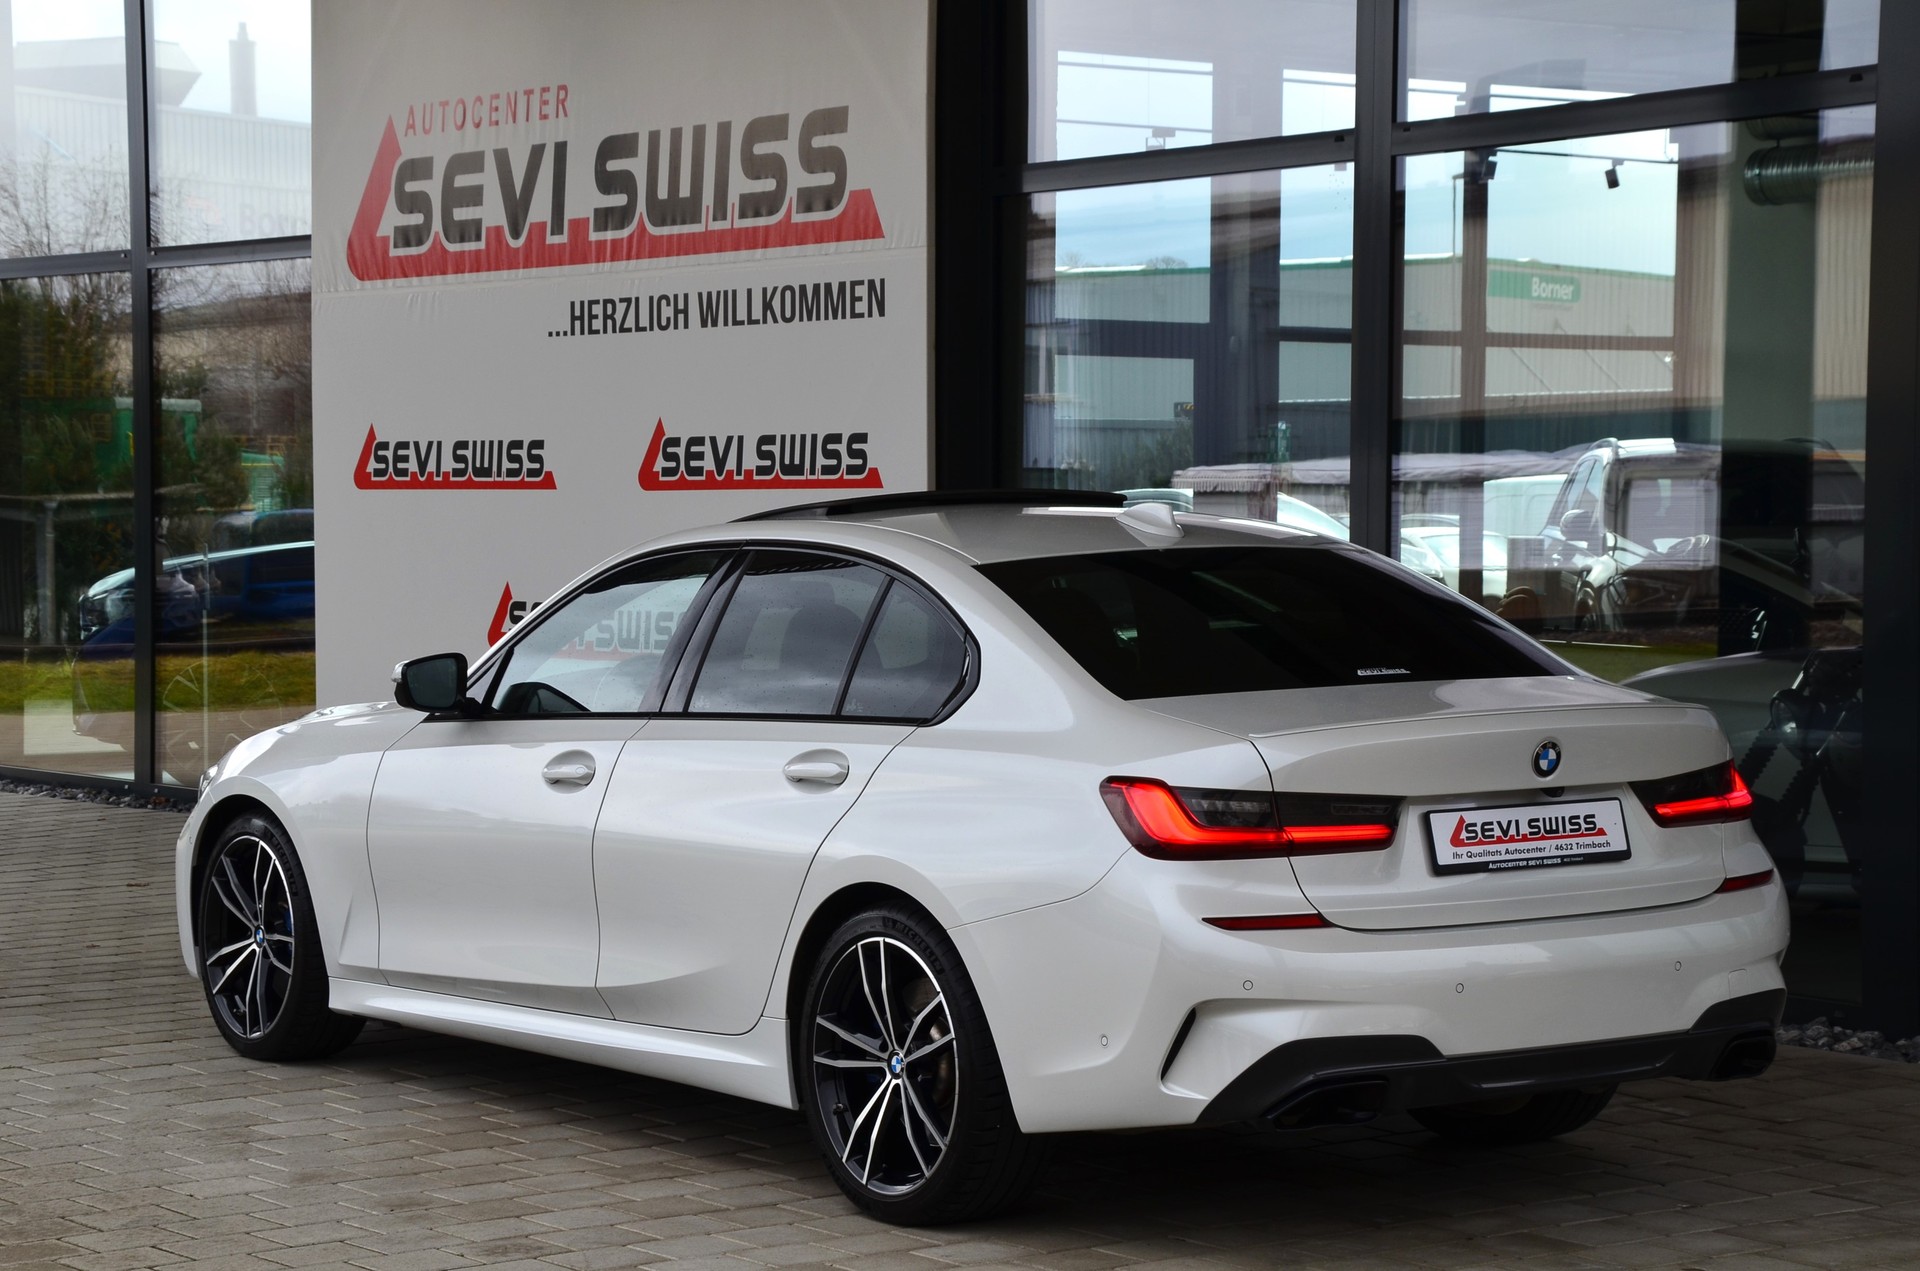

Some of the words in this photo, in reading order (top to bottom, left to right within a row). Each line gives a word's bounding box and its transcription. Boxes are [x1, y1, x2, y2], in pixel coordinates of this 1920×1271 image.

[404, 84, 569, 137] AUTOCENTER
[393, 140, 568, 249] SEVI
[593, 105, 849, 233] SWISS
[1531, 276, 1574, 300] Borner
[548, 293, 690, 338] ...HERZLICH
[697, 278, 886, 329] WILLKOMMEN
[373, 440, 442, 478] SEVI
[451, 439, 545, 478] SWISS
[660, 435, 744, 478] SEVI
[755, 432, 869, 477] SWISS
[1464, 819, 1520, 841] SEVI
[1527, 814, 1597, 837] SWISS
[1452, 851, 1464, 860] Ihr
[1504, 846, 1546, 856] Autocenter
[1554, 842, 1574, 852] 4632
[1575, 840, 1611, 850] Trimbach
[1528, 859, 1542, 867] SEVI
